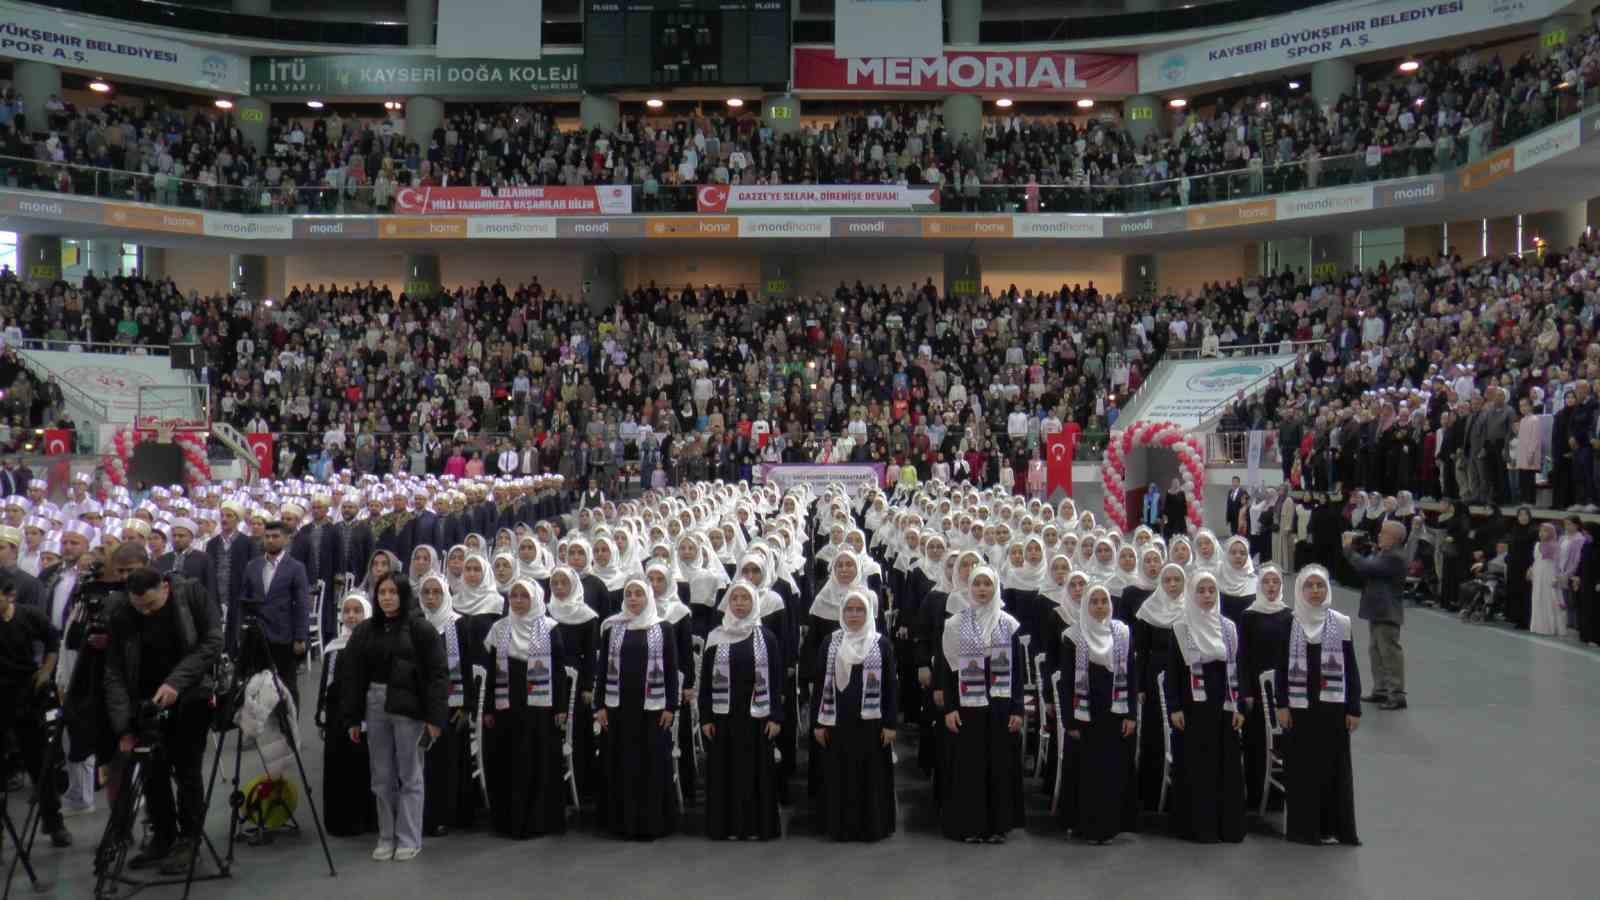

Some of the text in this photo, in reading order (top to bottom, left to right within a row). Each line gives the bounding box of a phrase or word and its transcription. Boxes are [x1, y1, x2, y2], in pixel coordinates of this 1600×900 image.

[1270, 20, 1365, 49] BÜYÜKŞEHİR
[1370, 1, 1463, 29] BELEDİYESİ
[86, 39, 178, 63] BELEDİYESİ
[1287, 40, 1332, 58] SPOR
[270, 58, 306, 81] İTÜ
[361, 64, 578, 83] KAYSERİ DOĞA KOLEJİ
[847, 55, 1088, 89] MEMORIAL
[1394, 184, 1434, 201] mondi
[18, 199, 62, 215] mondi
[310, 222, 344, 233] mondi
[575, 222, 609, 233] mondi
[698, 221, 730, 233] home
[757, 221, 822, 233] mondihome
[848, 221, 884, 233] mondi
[975, 221, 1006, 233] home
[1120, 217, 1152, 232] mondi
